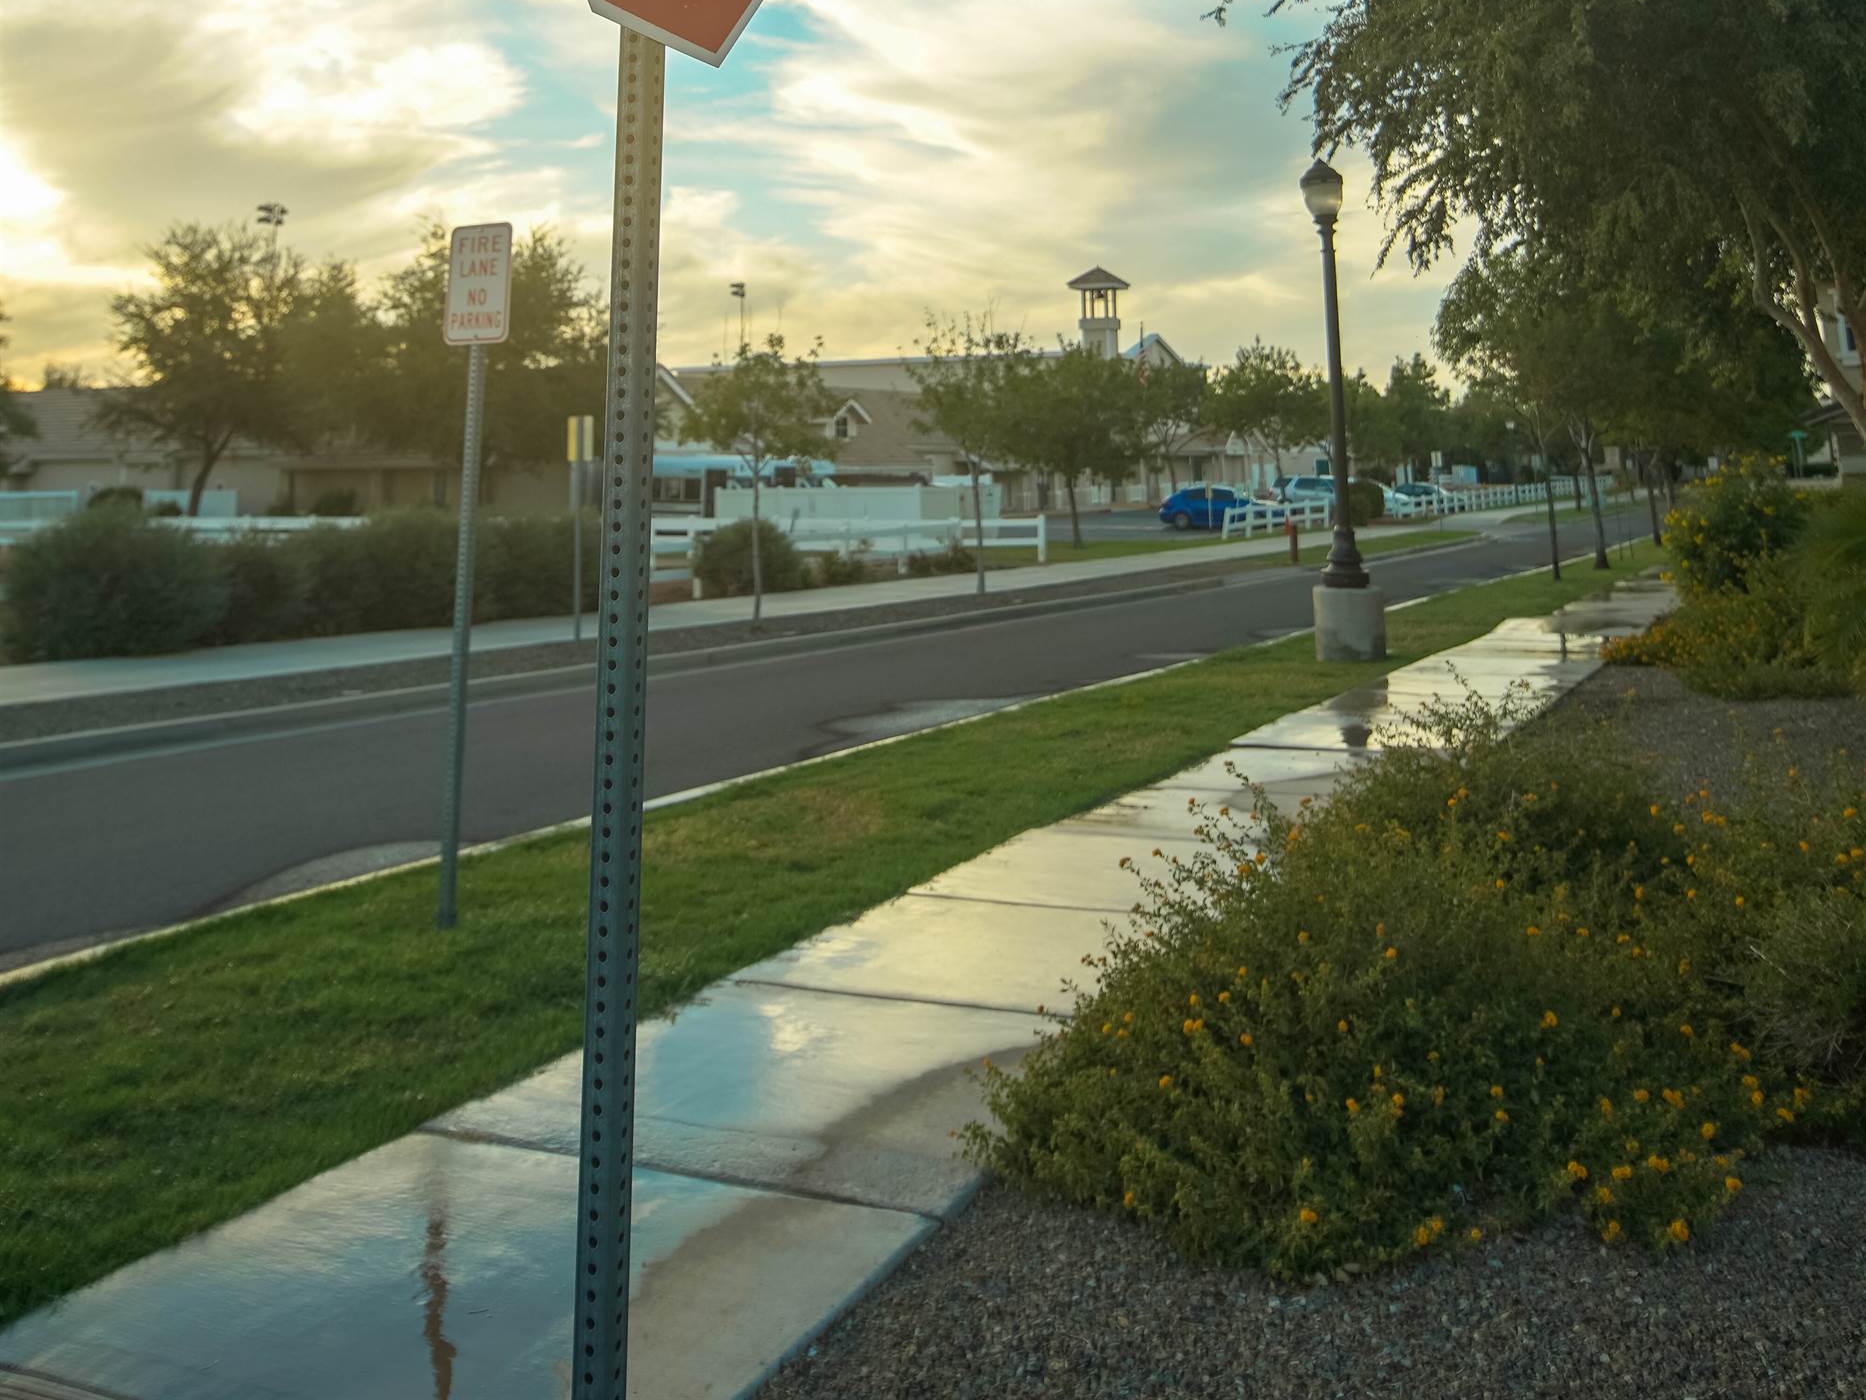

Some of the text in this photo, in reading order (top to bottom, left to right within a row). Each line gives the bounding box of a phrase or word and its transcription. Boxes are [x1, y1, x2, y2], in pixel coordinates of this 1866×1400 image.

[459, 234, 503, 255] FIRE
[459, 257, 498, 279] LANE
[466, 287, 487, 307] NO
[450, 310, 501, 330] PARKING
